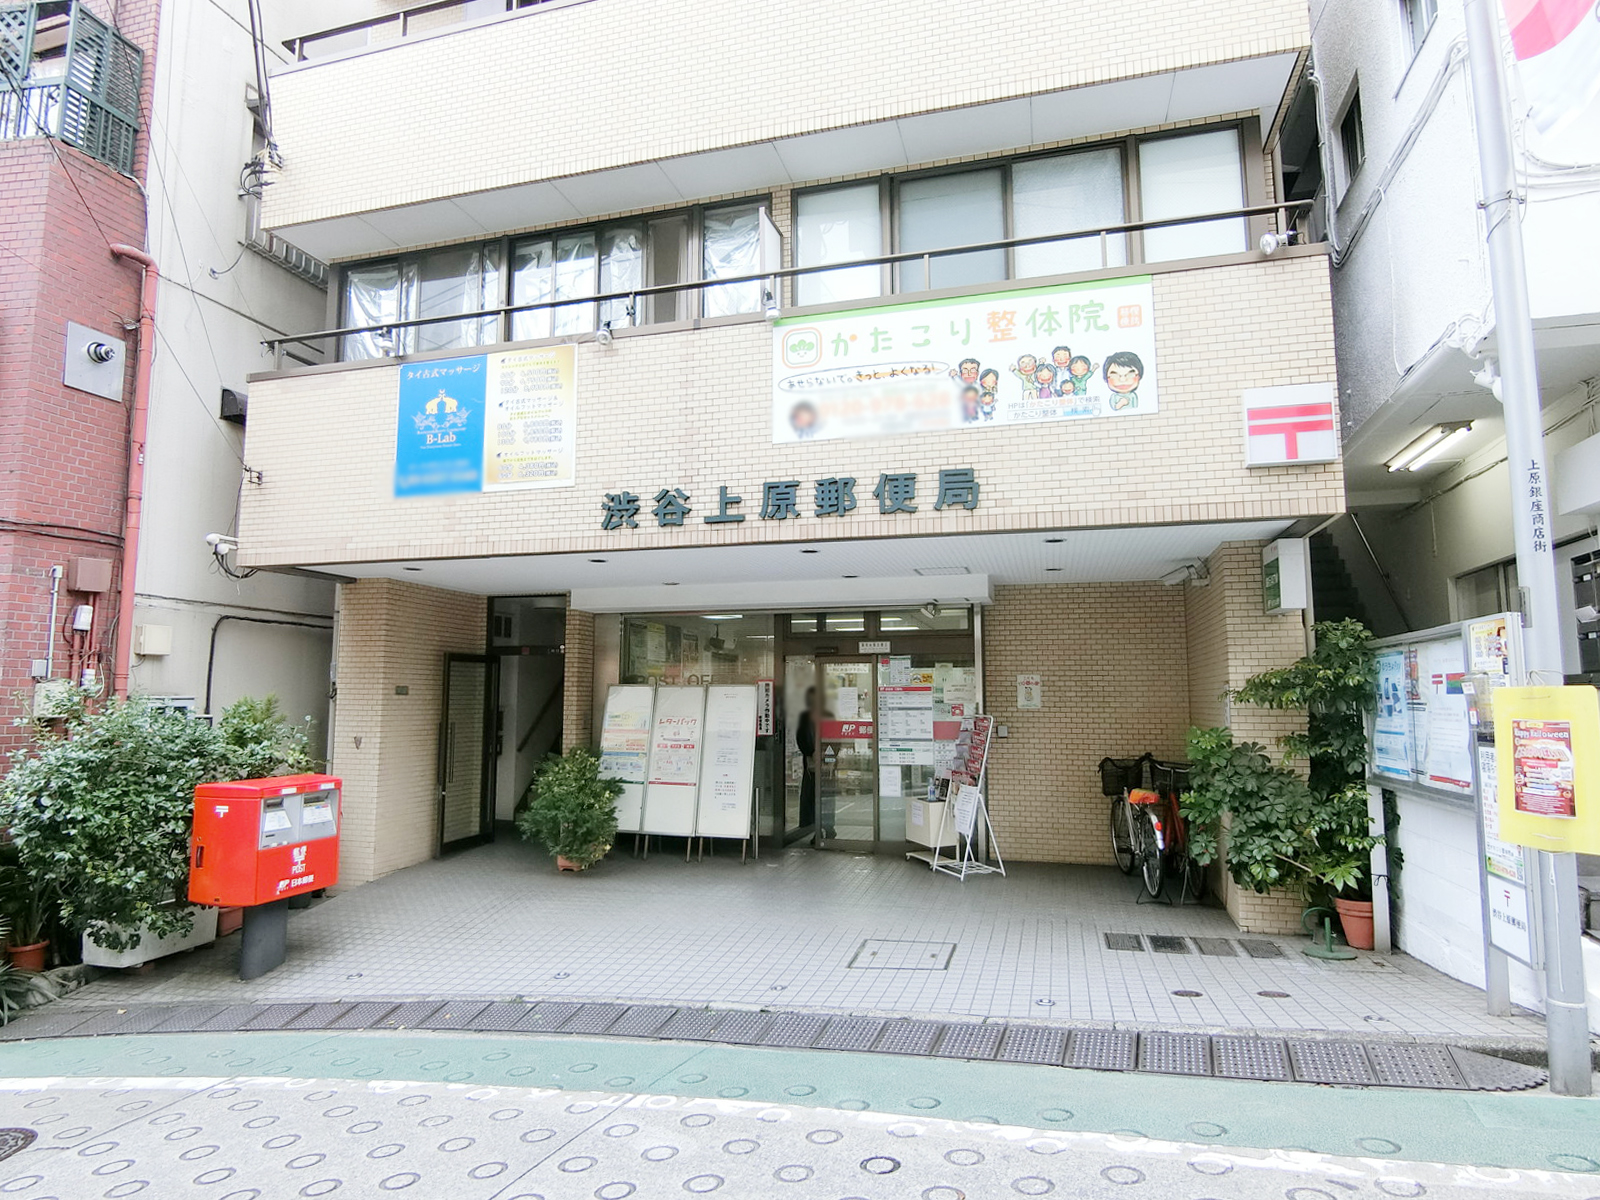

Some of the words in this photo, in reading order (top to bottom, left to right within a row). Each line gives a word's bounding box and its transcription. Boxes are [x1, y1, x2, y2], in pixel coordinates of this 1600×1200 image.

[830, 299, 1110, 357] かたこり整体院
[406, 363, 482, 380] タイ古式マッサージ
[426, 432, 457, 444] B-Lab
[600, 468, 981, 531] 渋谷上原郵便局
[1527, 459, 1547, 553] 上原銀座商店街
[658, 717, 698, 726] レターパック
[1530, 730, 1569, 739] Halloween
[291, 863, 306, 875] POST
[1492, 908, 1527, 932] 渋谷上原郵便局
